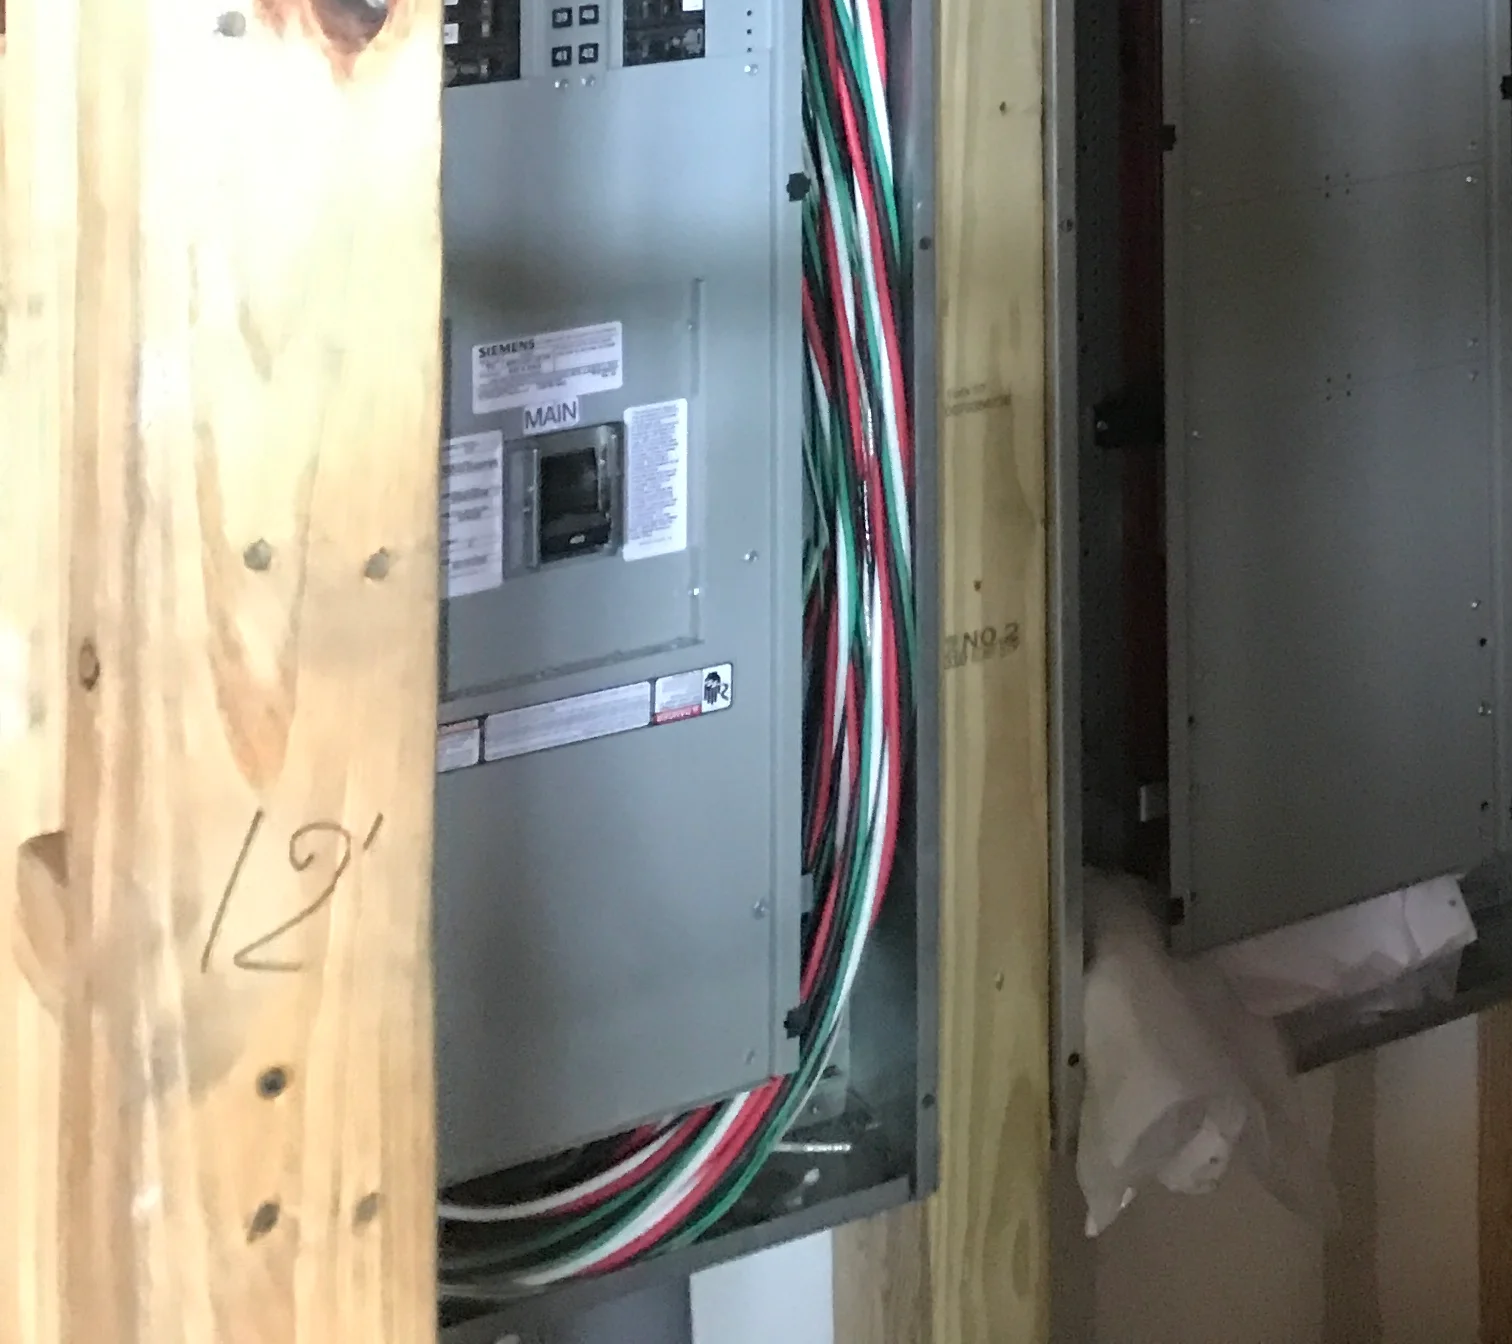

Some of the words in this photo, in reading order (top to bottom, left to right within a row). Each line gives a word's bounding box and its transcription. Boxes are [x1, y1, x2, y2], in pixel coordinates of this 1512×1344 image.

[478, 337, 536, 359] SIEMENS
[524, 400, 578, 430] MAIN
[201, 808, 384, 973] 12'
